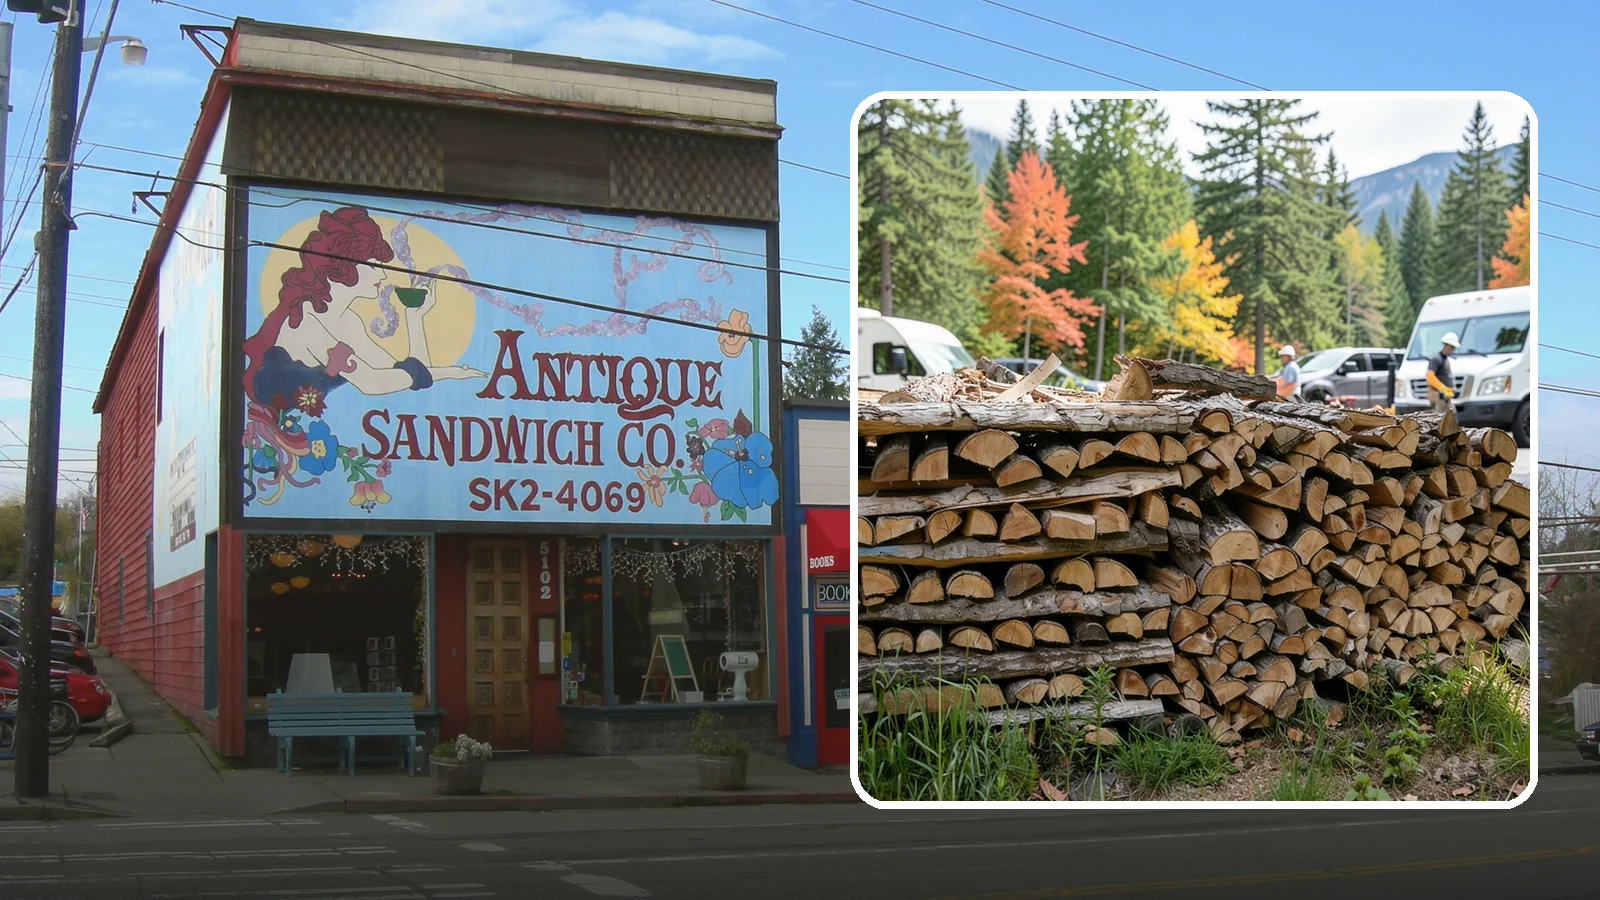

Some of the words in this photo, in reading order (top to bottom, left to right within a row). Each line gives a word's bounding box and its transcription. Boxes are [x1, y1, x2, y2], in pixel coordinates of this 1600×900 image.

[475, 329, 723, 421] ANTIQUE
[361, 409, 604, 467] SANDWICH
[617, 421, 685, 469] CO.
[468, 477, 646, 513] SK2-4069
[538, 541, 552, 600] 5102
[809, 554, 835, 569] BOOKS
